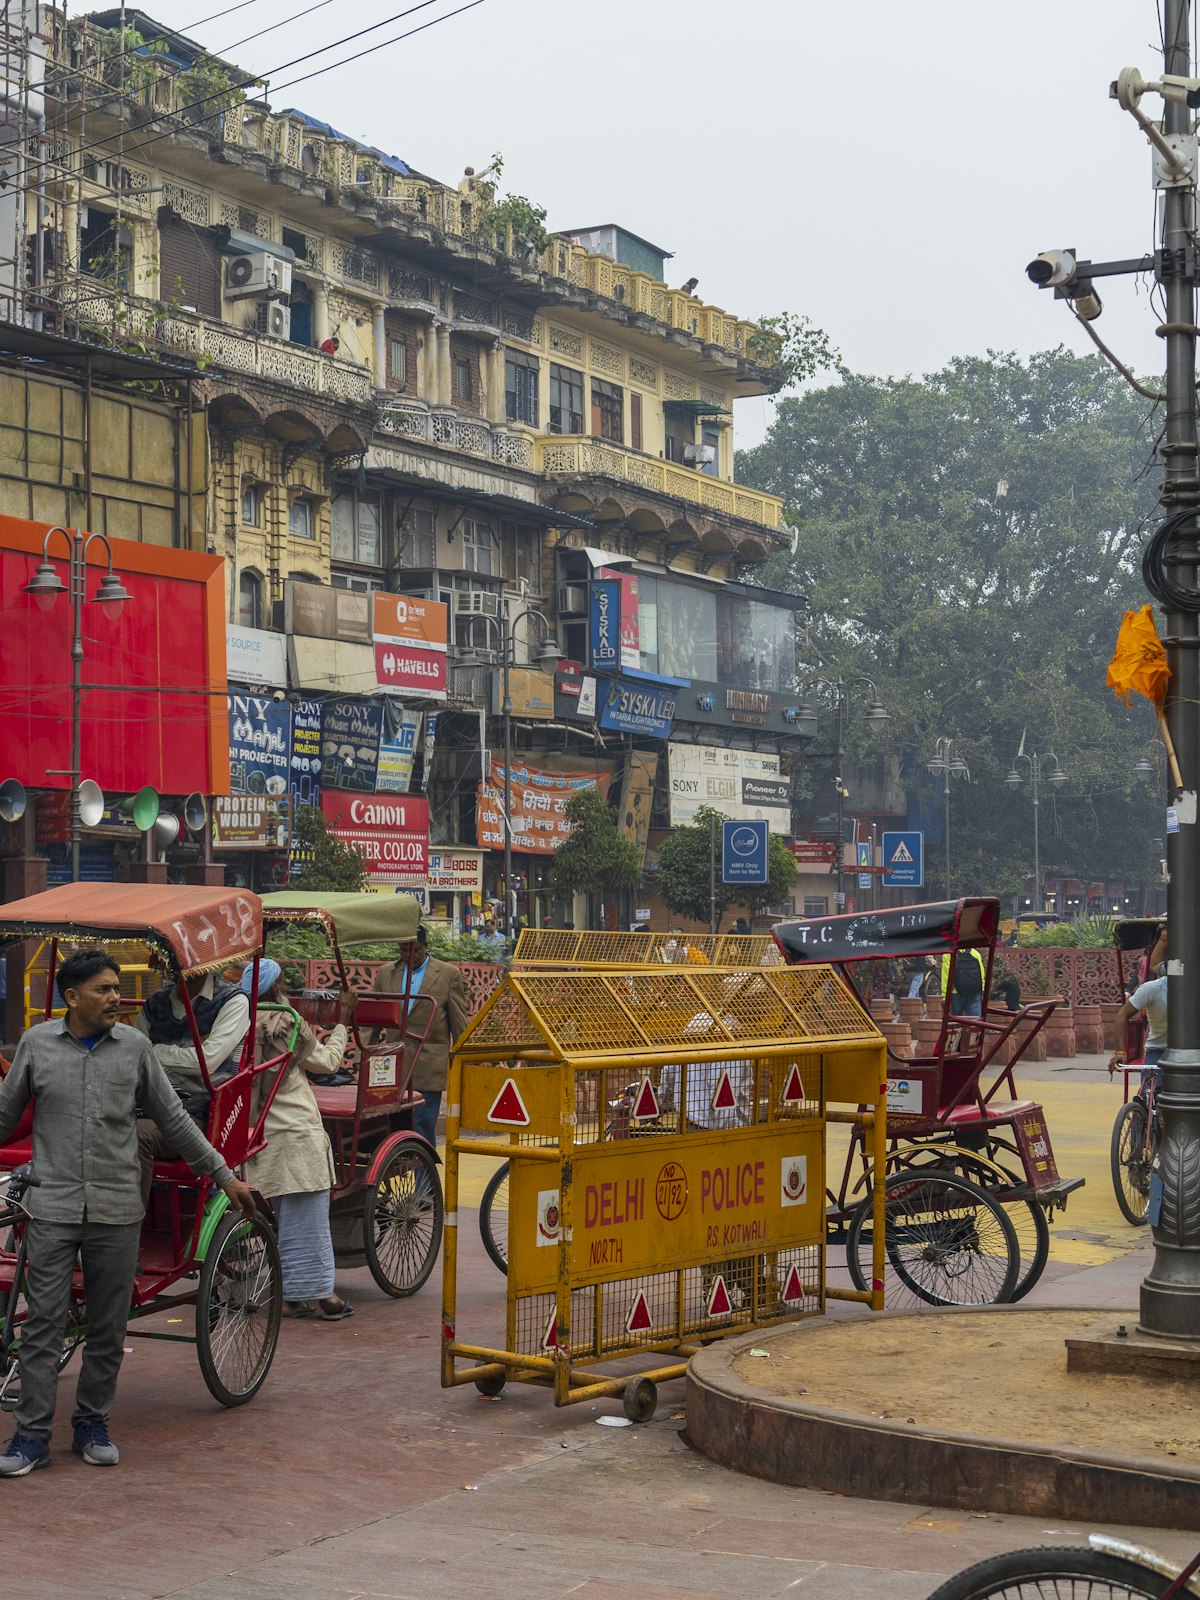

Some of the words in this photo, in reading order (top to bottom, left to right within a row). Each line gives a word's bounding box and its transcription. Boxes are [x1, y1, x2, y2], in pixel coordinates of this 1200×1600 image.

[231, 637, 262, 652] SOURCE
[593, 648, 616, 659] LED
[397, 657, 440, 677] HAVELLS
[334, 703, 372, 720] SONY
[657, 701, 676, 720] LED
[239, 748, 288, 768] PROJECTER
[673, 780, 699, 793] SONY
[706, 779, 737, 798] ELGIN
[746, 783, 776, 795] Pioneer
[216, 797, 266, 812] PROTEIN
[350, 800, 406, 827] Canon
[220, 812, 262, 828] WORLD
[384, 842, 425, 862] COLOR
[377, 862, 410, 872] PHOTOGRAPHIC
[410, 864, 425, 873] STORE
[438, 877, 478, 885] BROTHERS
[584, 1177, 646, 1230] DELHI
[701, 1161, 766, 1214] POLICE
[723, 1219, 767, 1247] KOTWALI
[589, 1238, 623, 1267] NORTH
